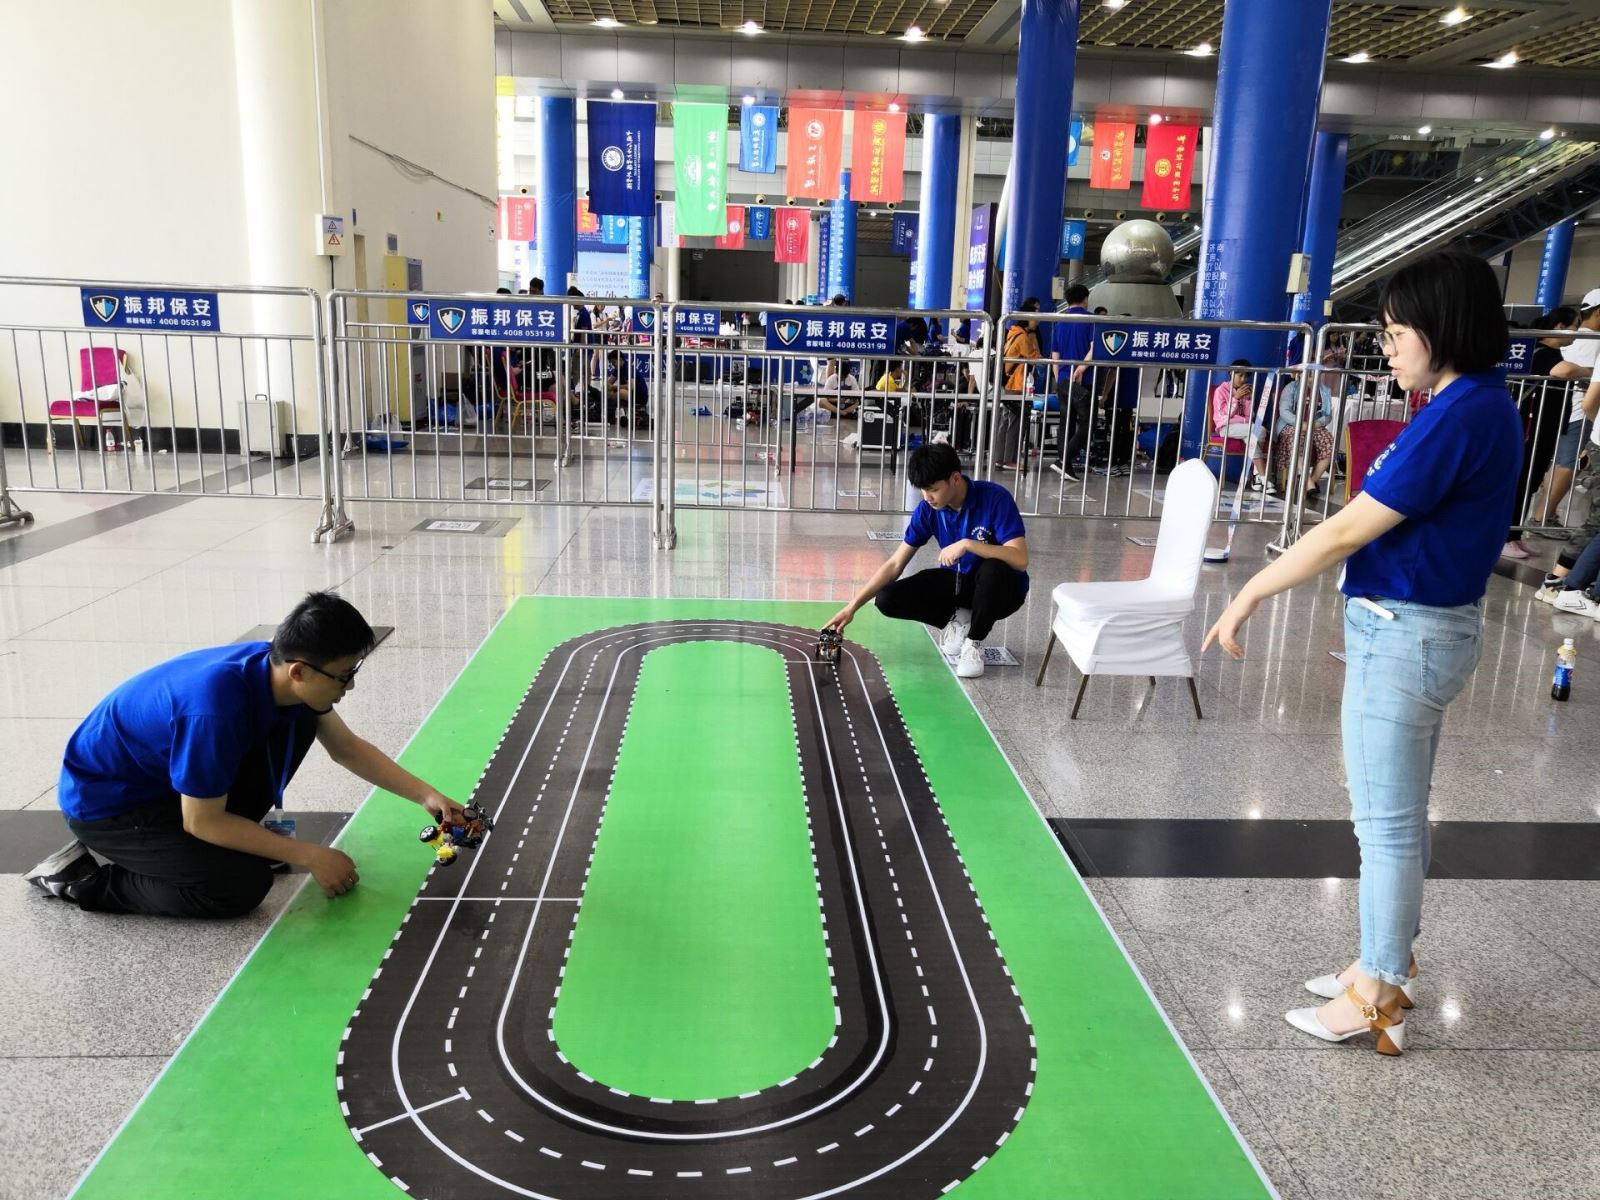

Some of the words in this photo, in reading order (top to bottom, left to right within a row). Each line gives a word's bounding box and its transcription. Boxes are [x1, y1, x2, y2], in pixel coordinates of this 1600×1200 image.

[124, 296, 211, 317] 振邦保安
[159, 318, 179, 326] 4008
[471, 308, 556, 327] 振邦保安
[503, 329, 523, 337] 4008
[806, 320, 888, 340] 振邦保安
[836, 341, 855, 349] 4008
[1132, 331, 1211, 350] 振邦保安
